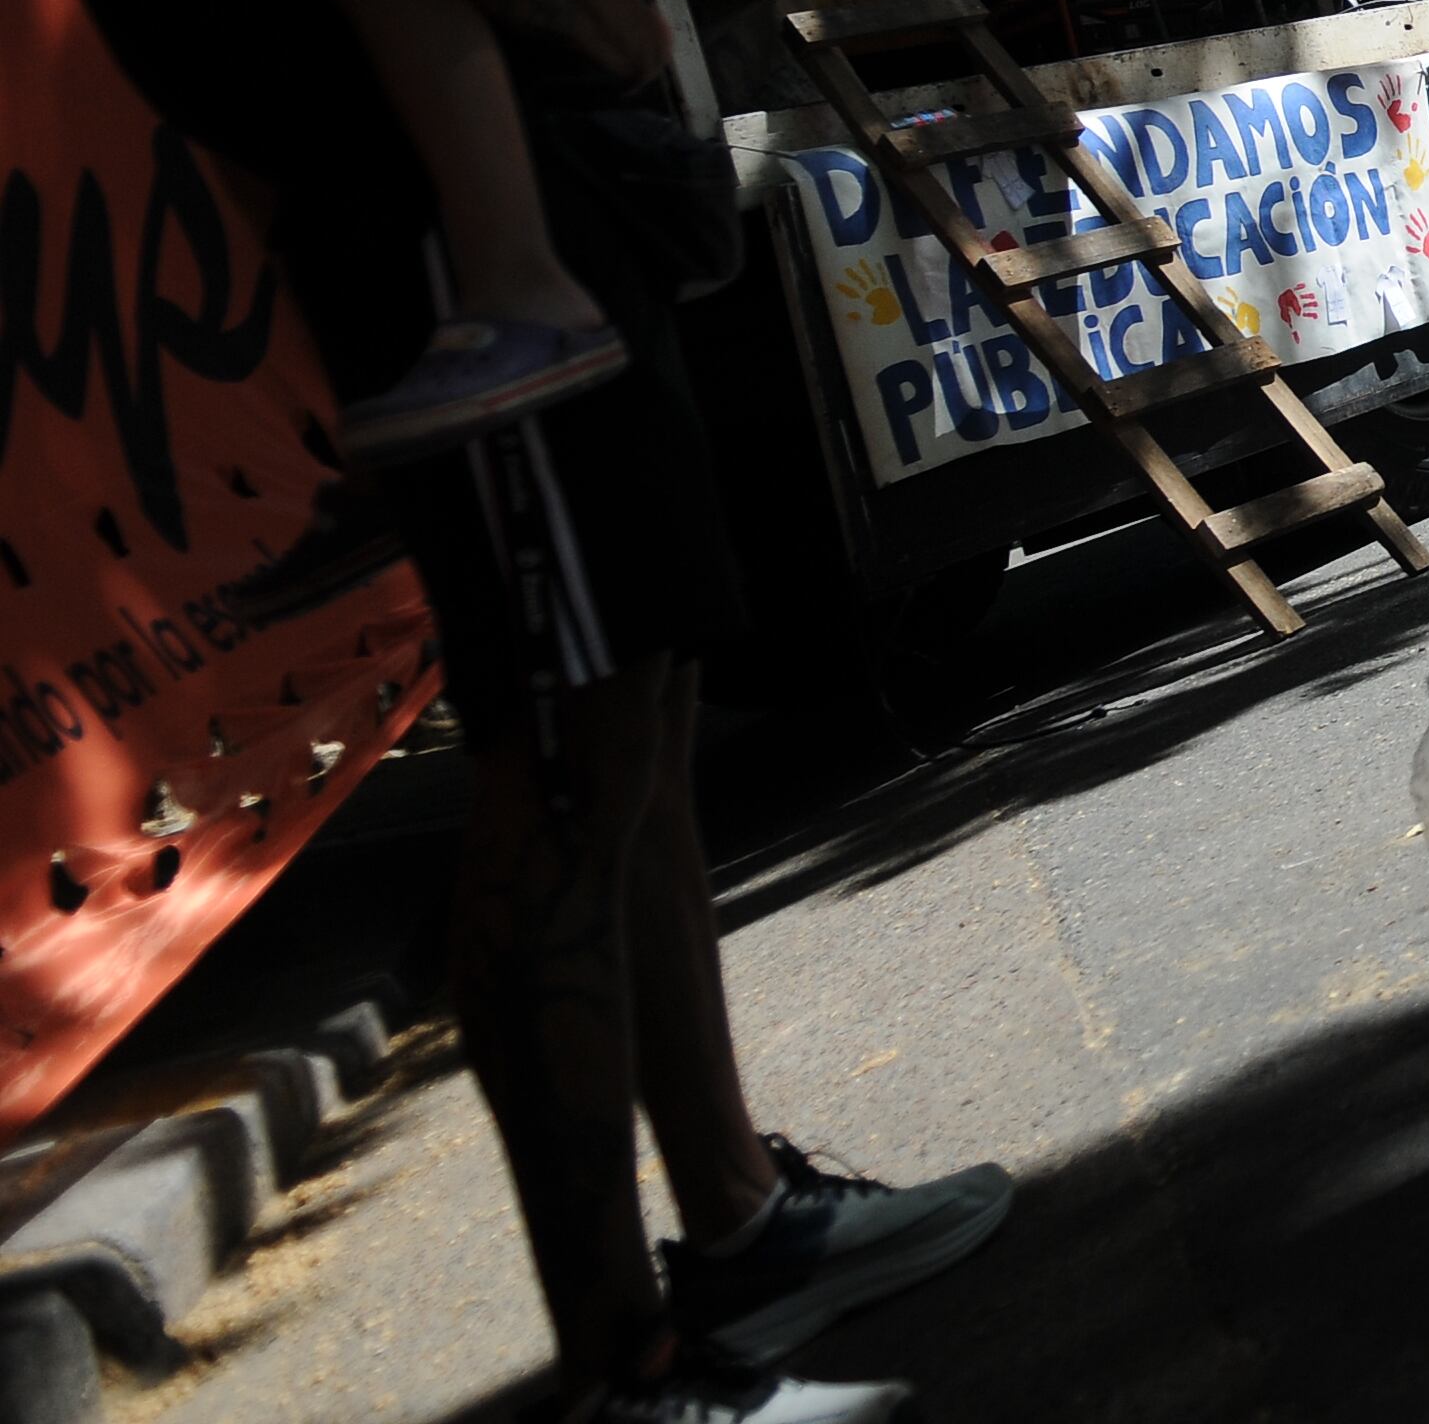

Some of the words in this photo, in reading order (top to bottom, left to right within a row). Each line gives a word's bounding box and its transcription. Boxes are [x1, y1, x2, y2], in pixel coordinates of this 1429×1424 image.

[884, 253, 1007, 347] LA
[66, 639, 157, 741] por
[118, 606, 207, 682] la
